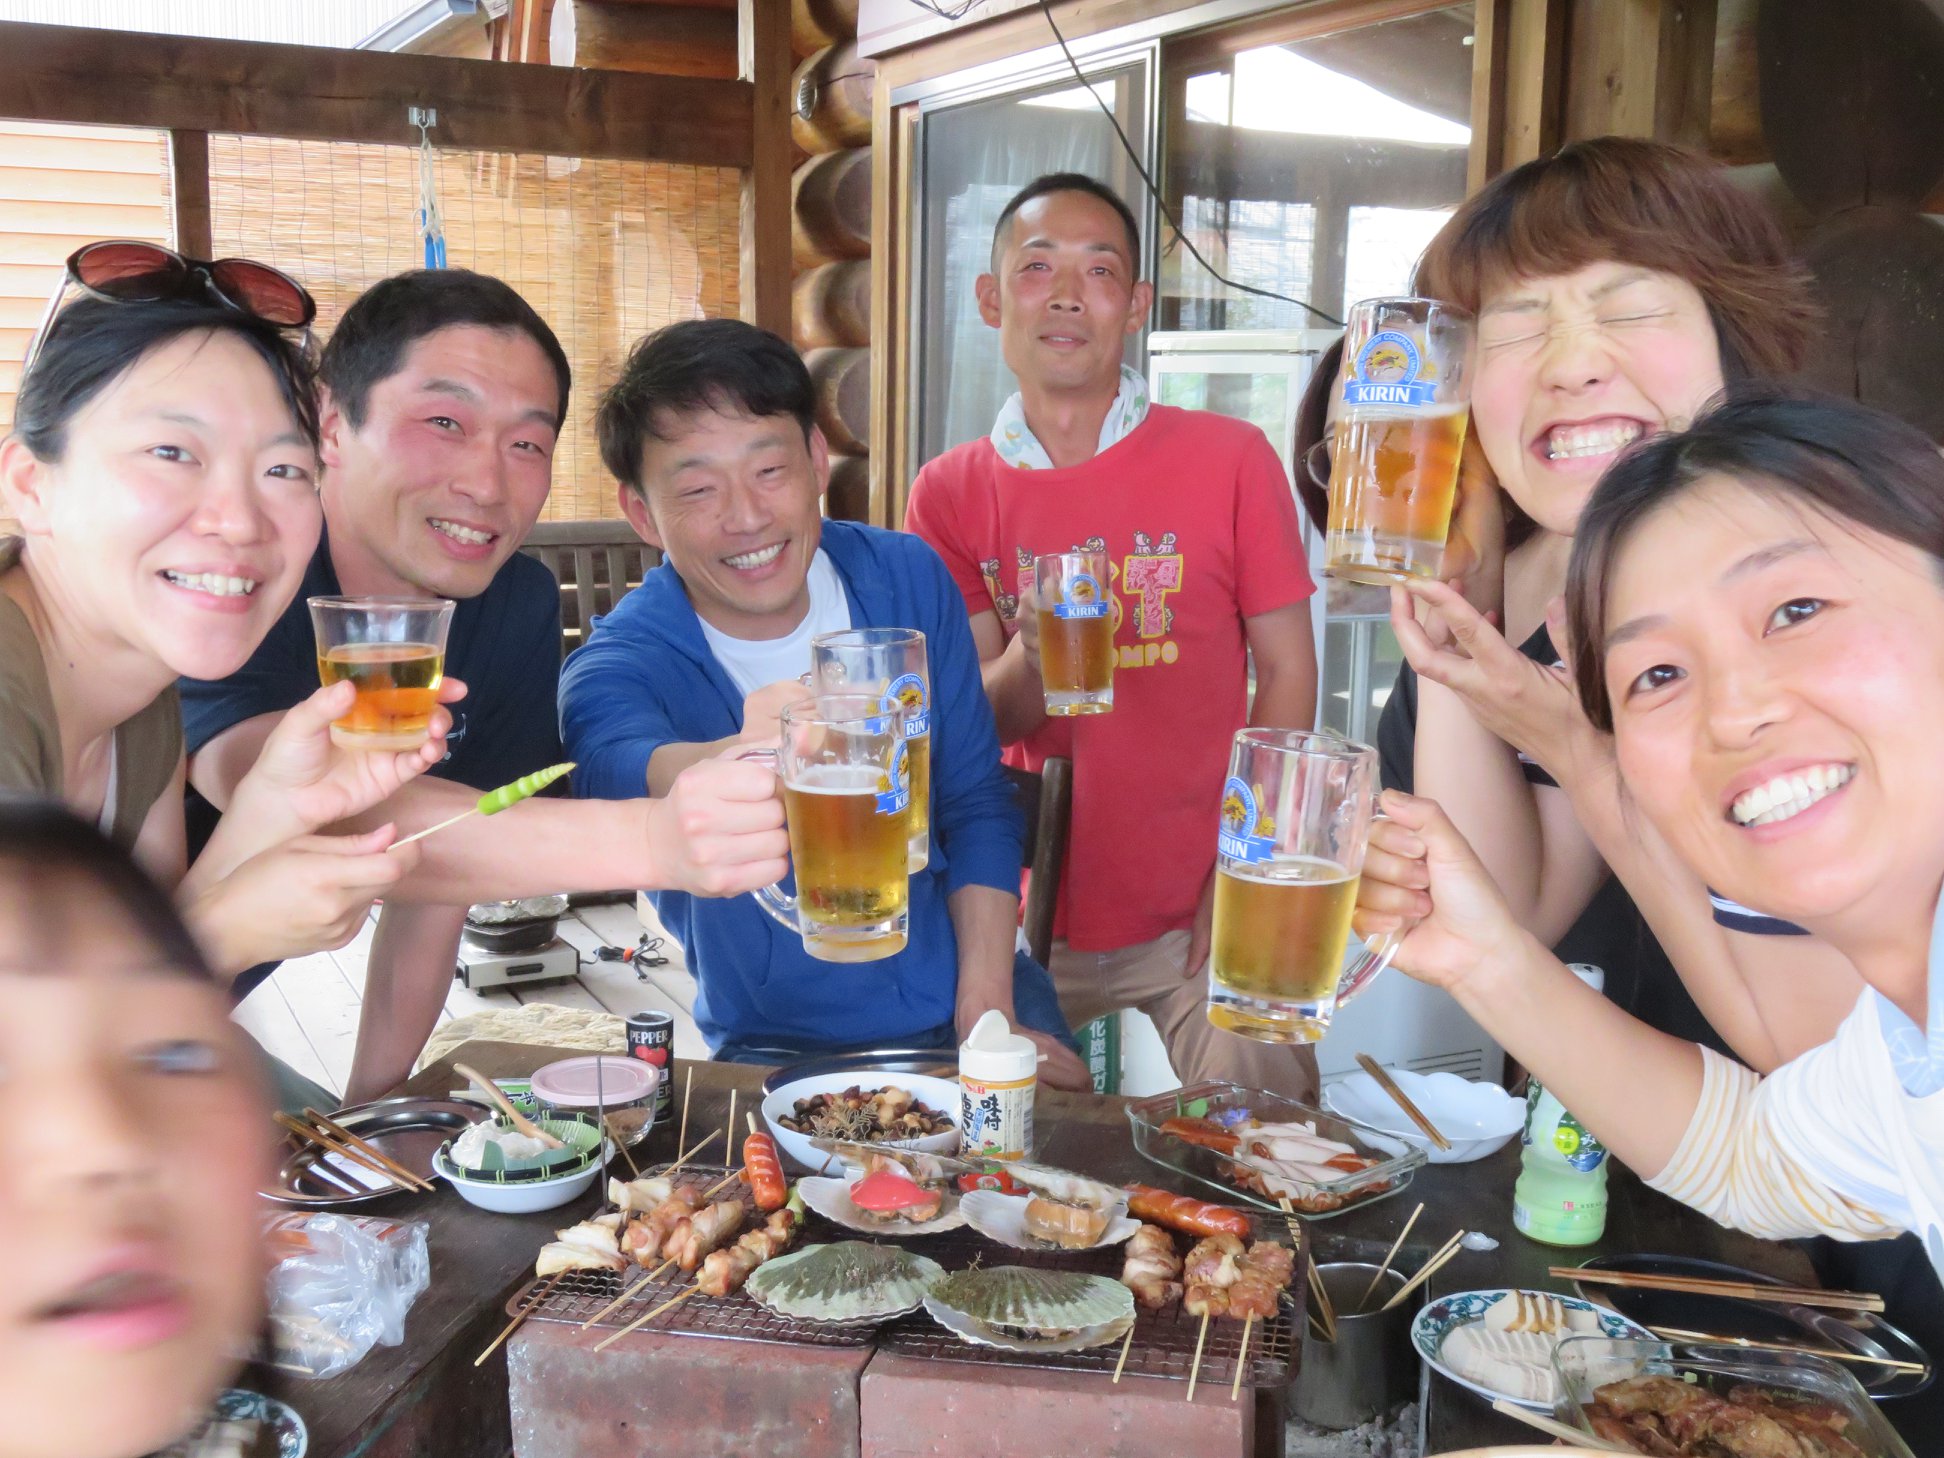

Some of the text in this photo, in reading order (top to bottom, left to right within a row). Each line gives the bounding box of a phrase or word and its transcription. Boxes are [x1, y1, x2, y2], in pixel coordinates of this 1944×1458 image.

[1383, 333, 1415, 353] COMPANY
[1357, 385, 1411, 403] KIRIN
[1067, 606, 1099, 618] KIRIN
[880, 718, 926, 736] KRIN
[629, 1029, 668, 1044] PEPPER
[965, 1083, 986, 1095] S&B
[980, 1093, 1002, 1131] 味付
